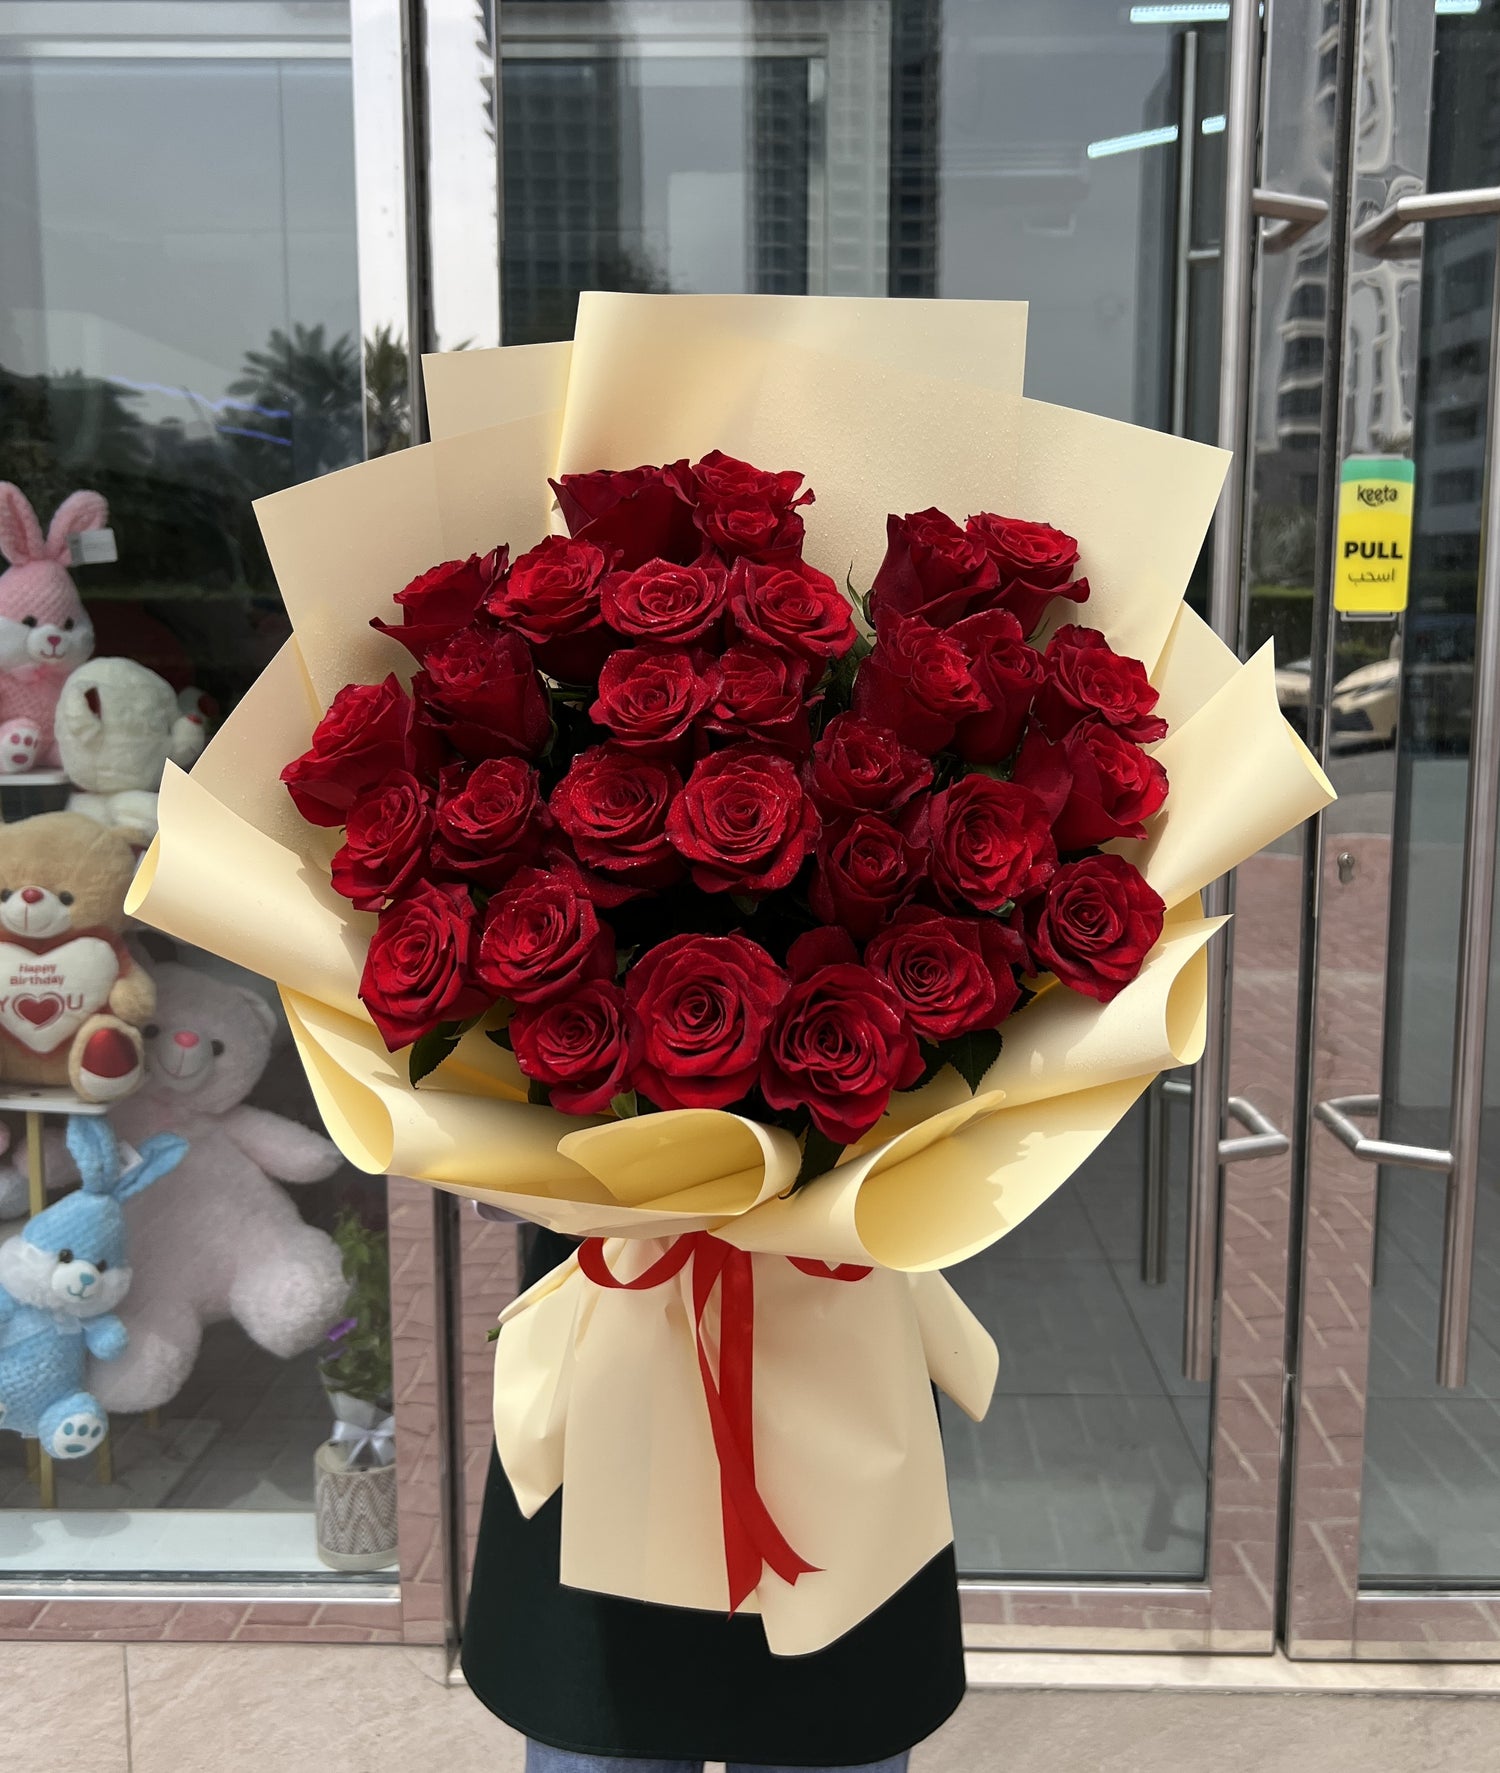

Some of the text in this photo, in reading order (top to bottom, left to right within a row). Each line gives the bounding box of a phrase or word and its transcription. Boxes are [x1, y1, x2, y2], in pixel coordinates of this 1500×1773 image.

[1357, 485, 1398, 506] keeta
[1344, 541, 1403, 559] PULL
[1347, 568, 1396, 586] اسحب
[19, 963, 57, 974] Happy
[10, 976, 65, 986] Birthday
